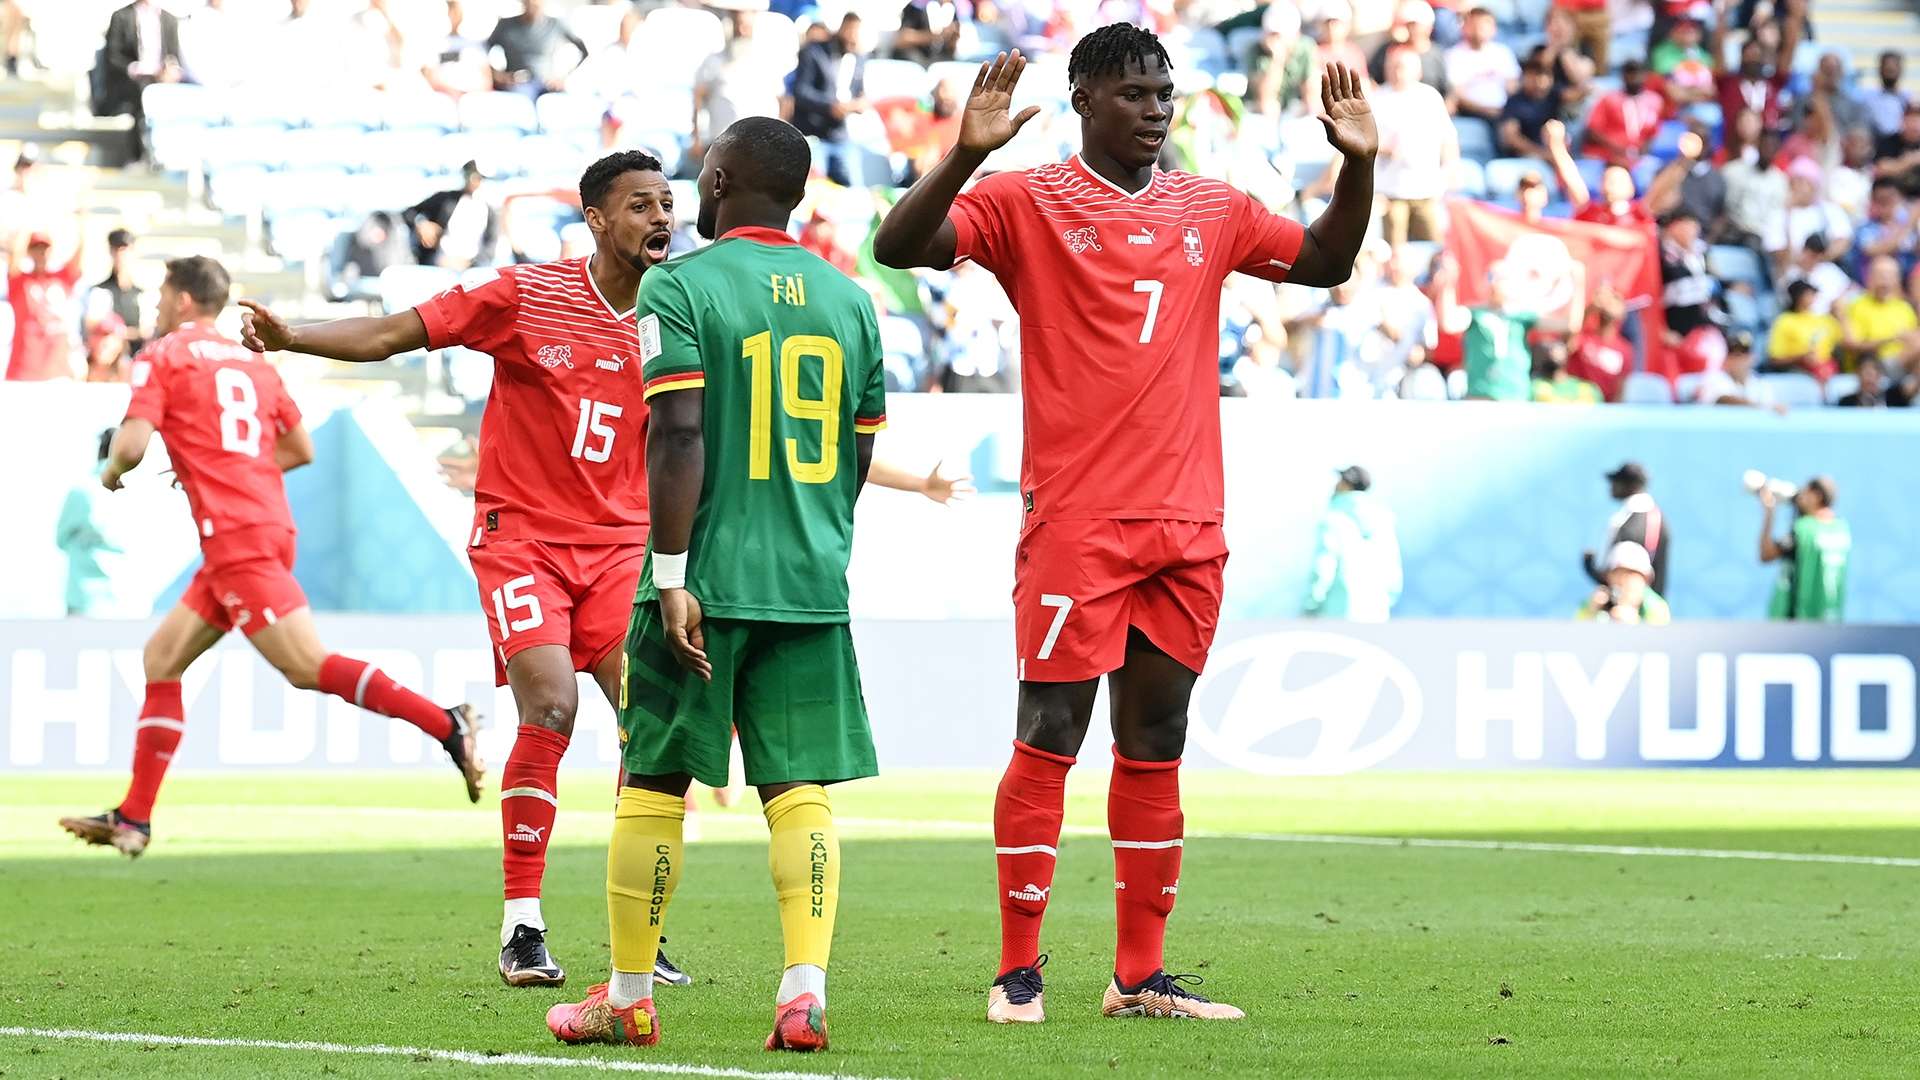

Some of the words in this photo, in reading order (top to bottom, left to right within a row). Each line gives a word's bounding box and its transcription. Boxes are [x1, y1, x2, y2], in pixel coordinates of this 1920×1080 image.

[771, 273, 807, 306] FAÏ
[1133, 279, 1164, 344] 7
[595, 358, 620, 372] PUMA
[214, 367, 262, 458] 8
[570, 397, 623, 464] 15
[742, 330, 843, 484] 19
[491, 573, 544, 641] 15
[1036, 593, 1074, 660] 7
[508, 833, 536, 842] PUMA
[650, 844, 670, 927] CAMEROUN
[810, 832, 827, 918] CAMEROUN
[1008, 890, 1041, 901] PUMA
